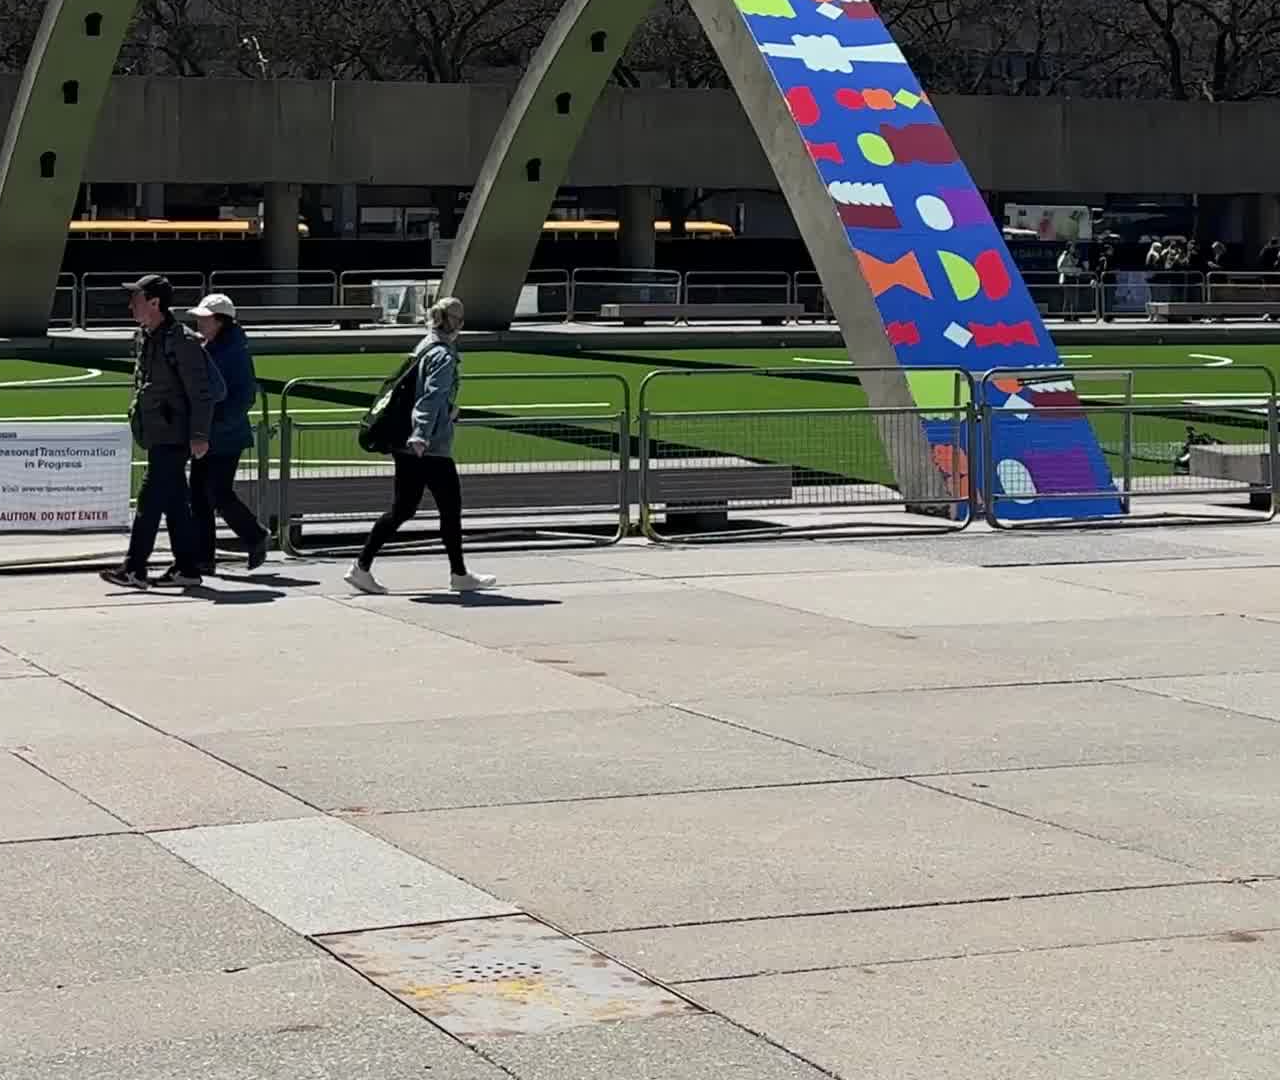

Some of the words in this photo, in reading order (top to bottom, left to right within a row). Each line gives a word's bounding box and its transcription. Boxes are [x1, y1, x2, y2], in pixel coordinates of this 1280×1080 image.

[40, 447, 116, 457] Transformation
[24, 460, 35, 469] in
[38, 460, 83, 471] Progress
[41, 511, 55, 521] DO
[57, 511, 77, 521] NOT
[78, 511, 109, 521] ENTER
